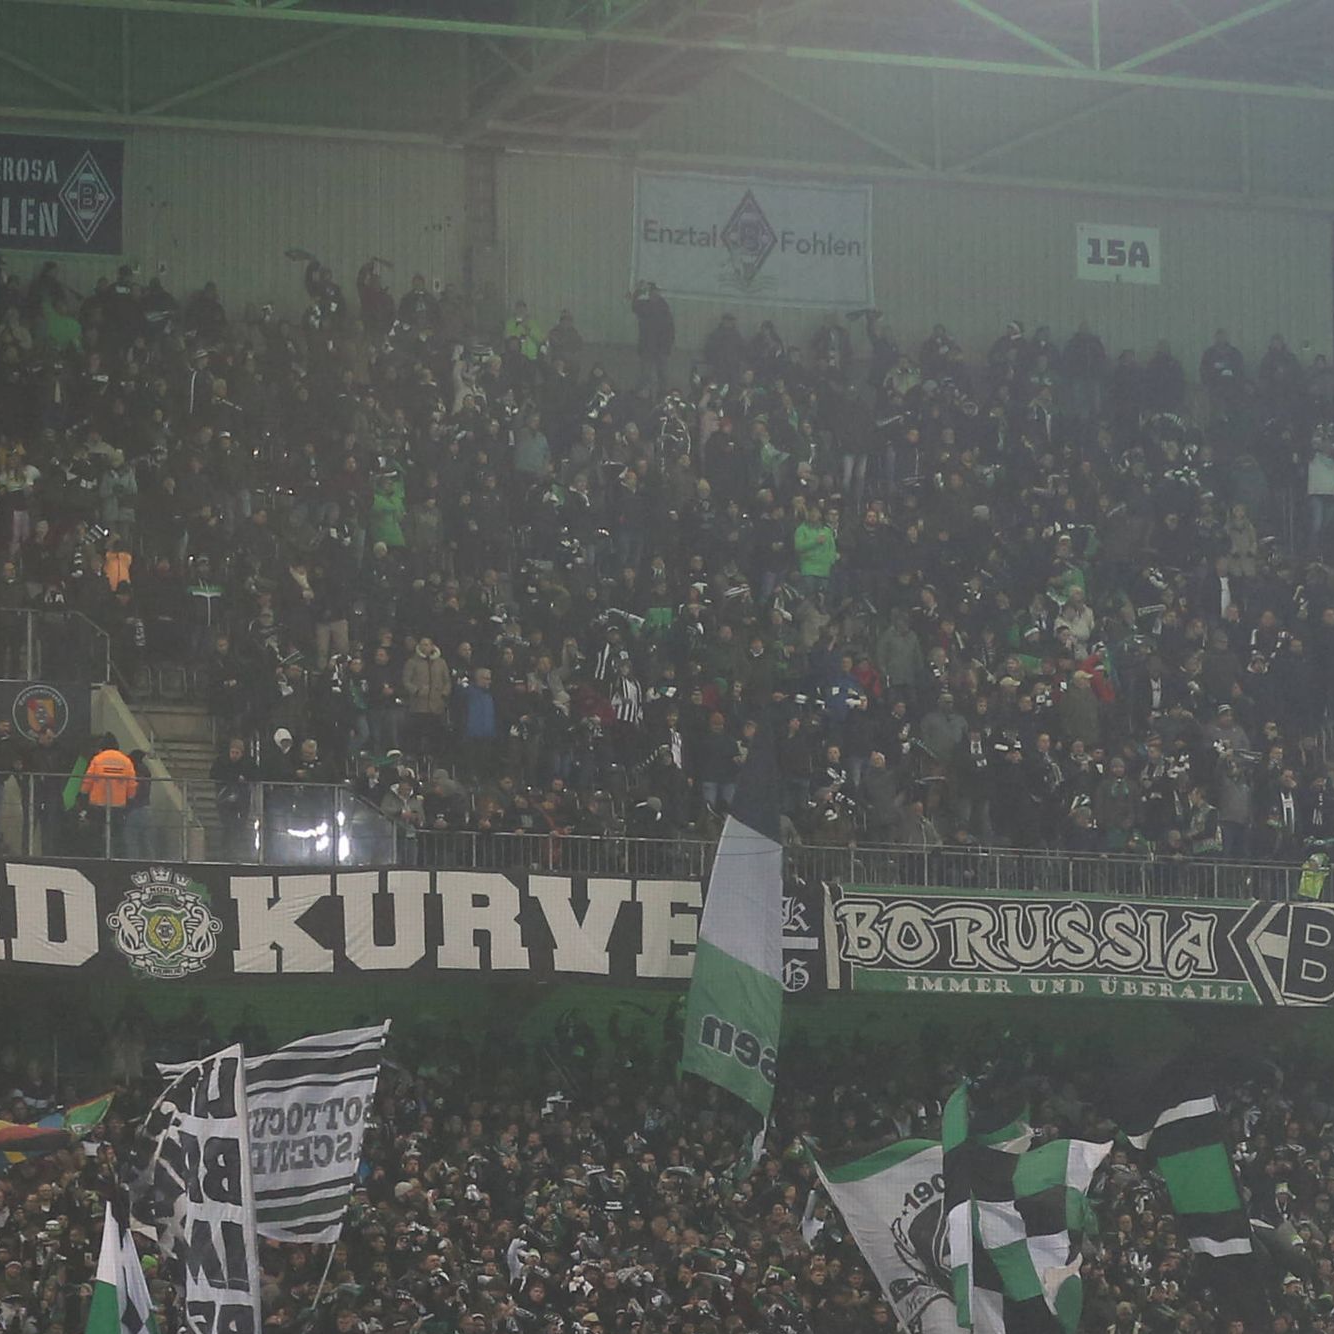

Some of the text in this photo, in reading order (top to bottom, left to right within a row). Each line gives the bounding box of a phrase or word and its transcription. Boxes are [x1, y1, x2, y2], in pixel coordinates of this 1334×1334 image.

[643, 220, 861, 258] Enztal Fohlen
[1086, 237, 1150, 268] 15A
[231, 869, 703, 980] KURVE
[836, 899, 1218, 981] BORUSSIA
[905, 975, 1244, 1001] IMMER UND ÜBERALL!
